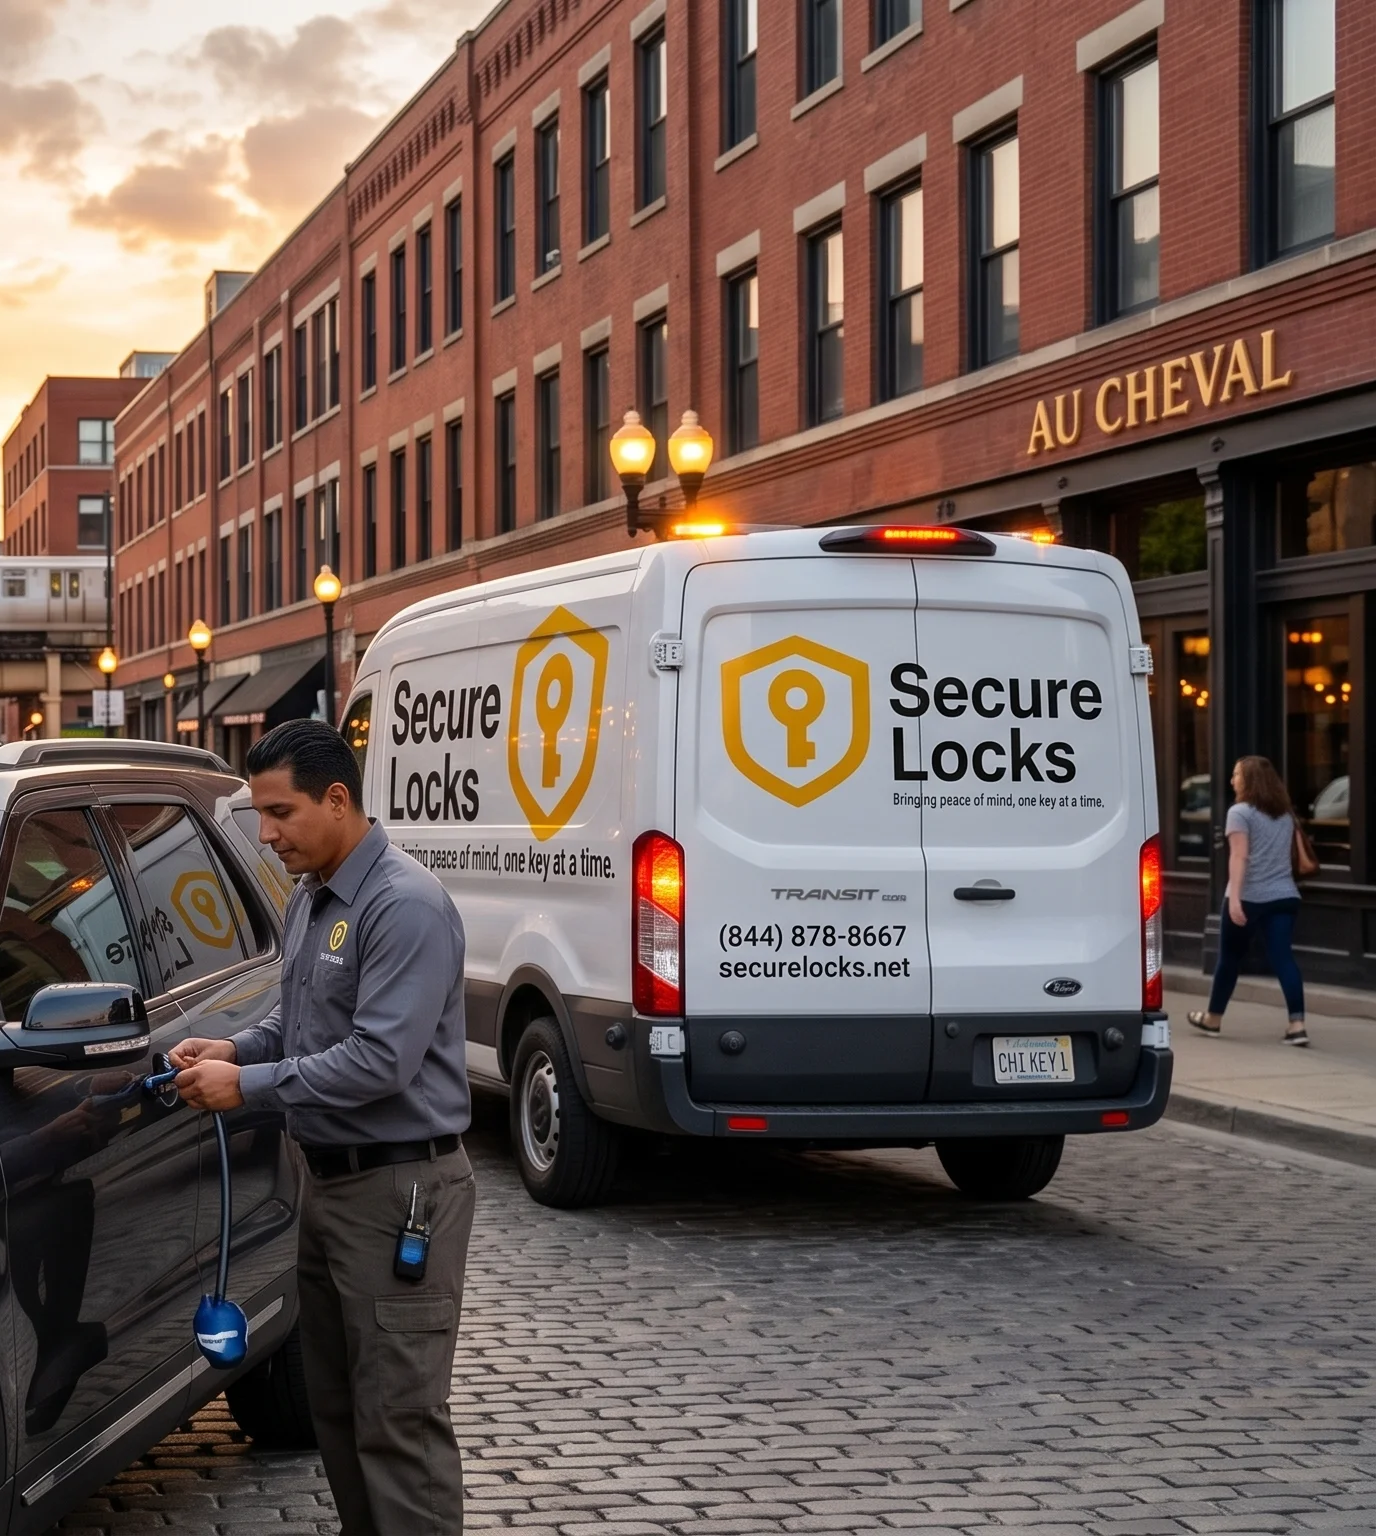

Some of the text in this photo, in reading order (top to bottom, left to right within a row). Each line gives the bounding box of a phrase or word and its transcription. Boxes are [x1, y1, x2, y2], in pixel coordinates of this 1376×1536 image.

[1027, 329, 1292, 454] AU CHEVAL
[889, 662, 1102, 721] Secure
[392, 679, 501, 746] Secure
[892, 726, 1077, 784] Locks
[389, 752, 479, 822] Locks
[893, 793, 1105, 810] Bringing peace of mind, one key at a time.
[429, 848, 458, 872] peace
[459, 844, 471, 870] of
[472, 844, 501, 876] mind,
[504, 851, 525, 873] one
[528, 845, 550, 883] key
[553, 849, 566, 876] at
[569, 854, 577, 876] a
[580, 847, 616, 879] time.
[771, 888, 880, 901] TRANSIT
[719, 923, 907, 952] (844) 878-8667
[719, 955, 910, 978] securelocks.net
[998, 1052, 1026, 1073] CHI
[1030, 1051, 1056, 1073] KEY
